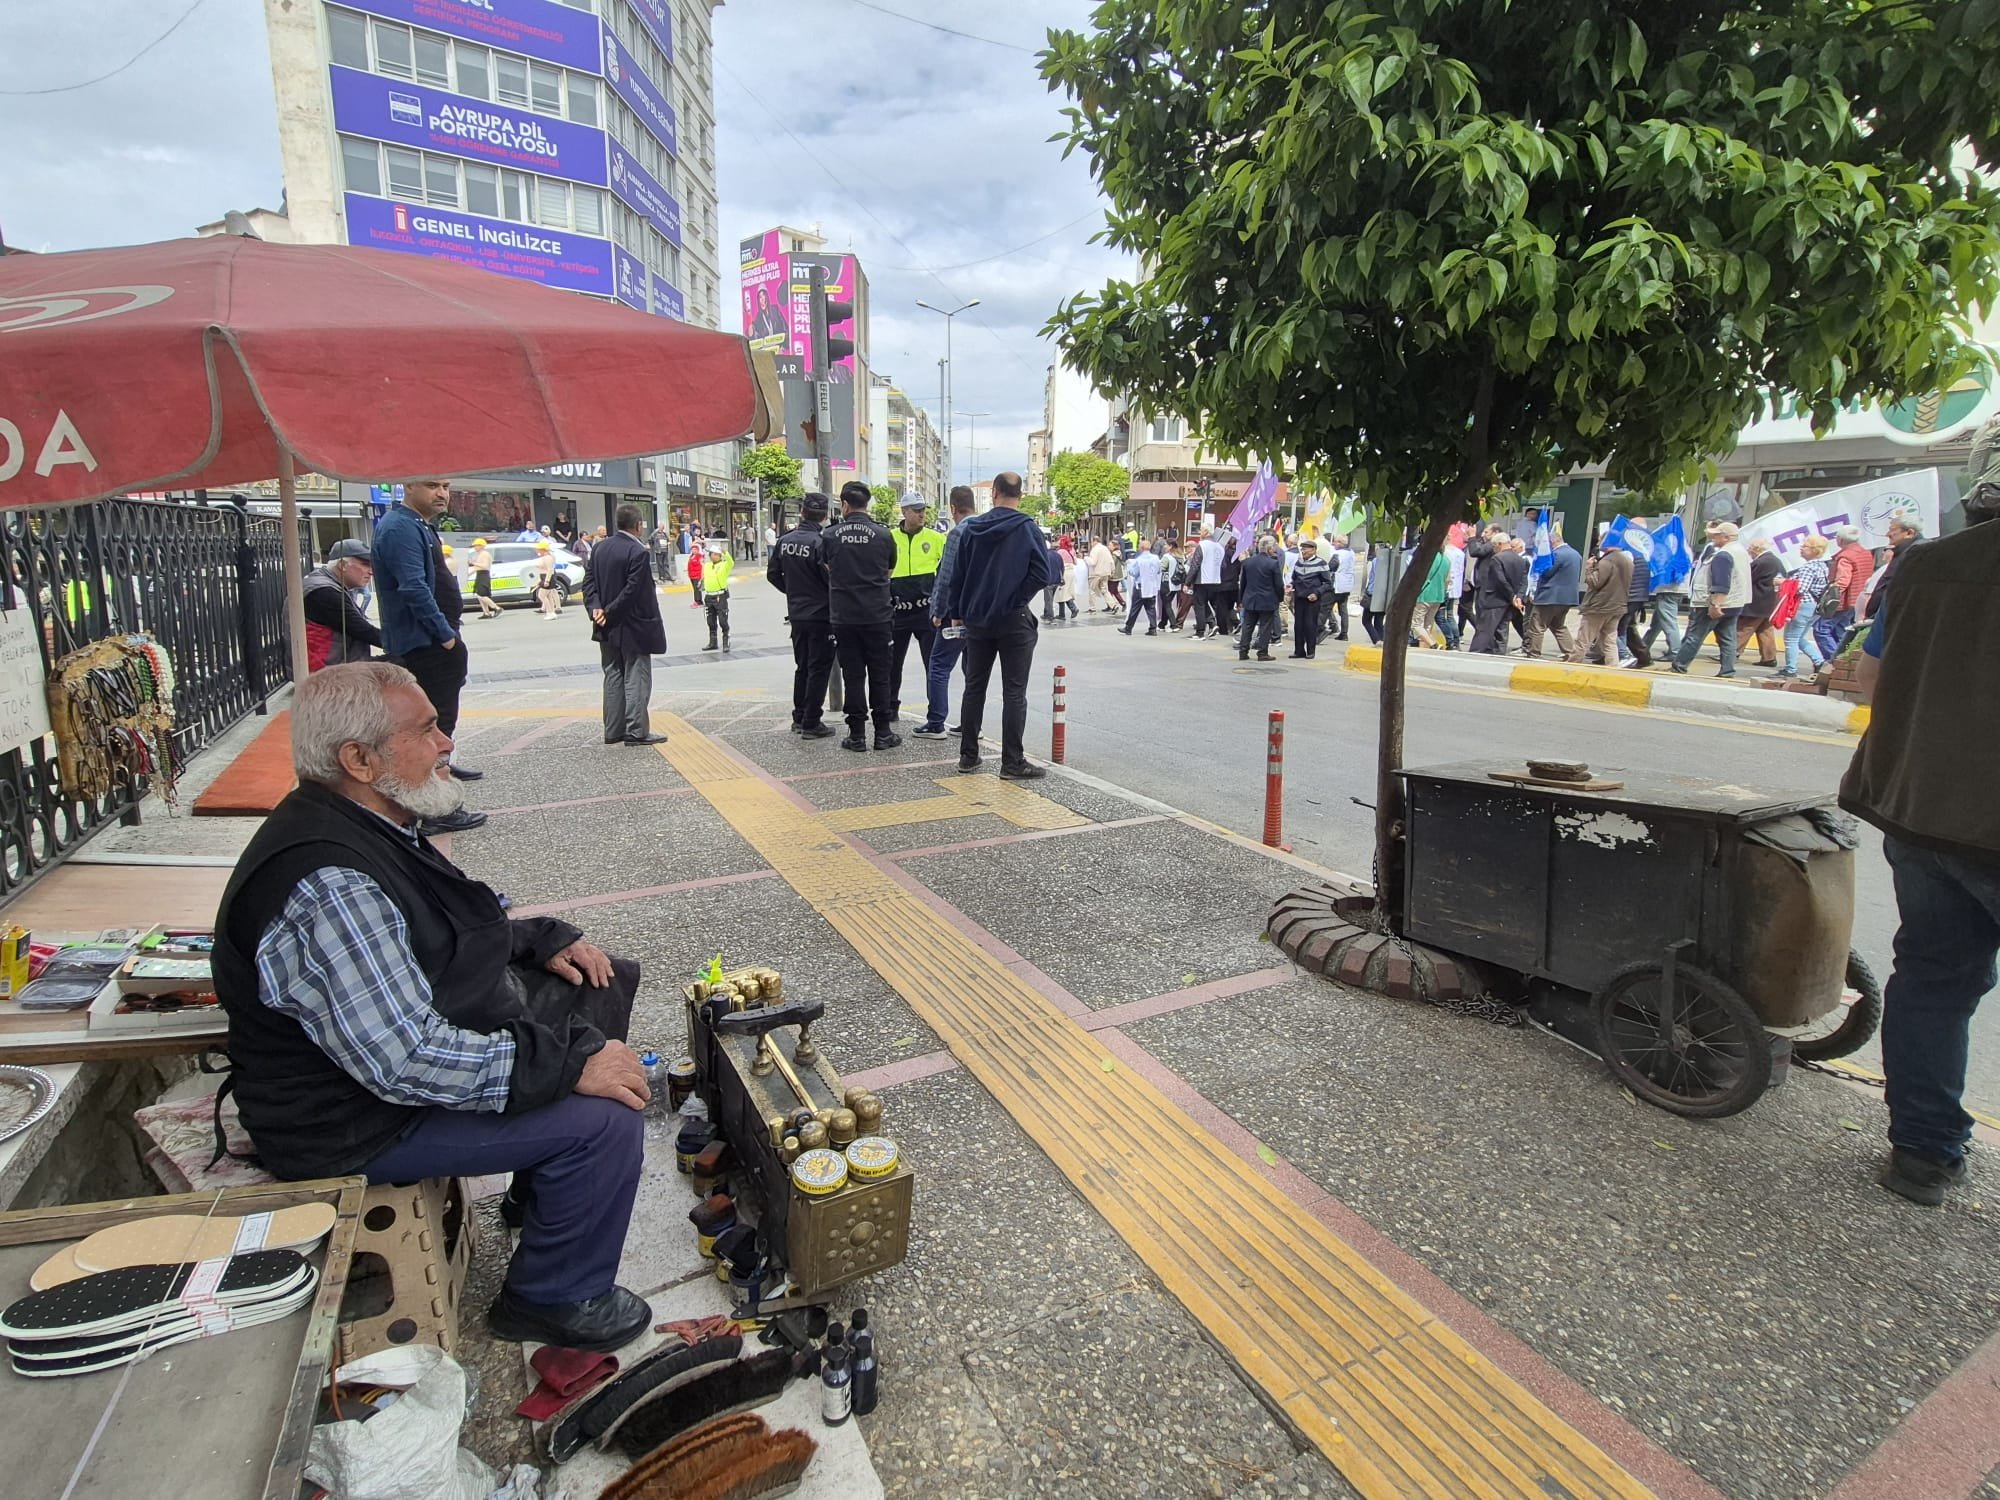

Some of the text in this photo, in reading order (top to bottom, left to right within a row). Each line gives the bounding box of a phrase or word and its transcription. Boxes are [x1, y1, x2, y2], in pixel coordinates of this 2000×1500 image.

[429, 115, 558, 157] PORTFOLYOSU
[440, 104, 547, 141] AVRUPA DİL
[412, 216, 562, 255] GENEL İNGİLİZCE
[776, 365, 797, 374] AR
[819, 383, 829, 411] EFELER
[853, 523, 876, 539] KUVVET
